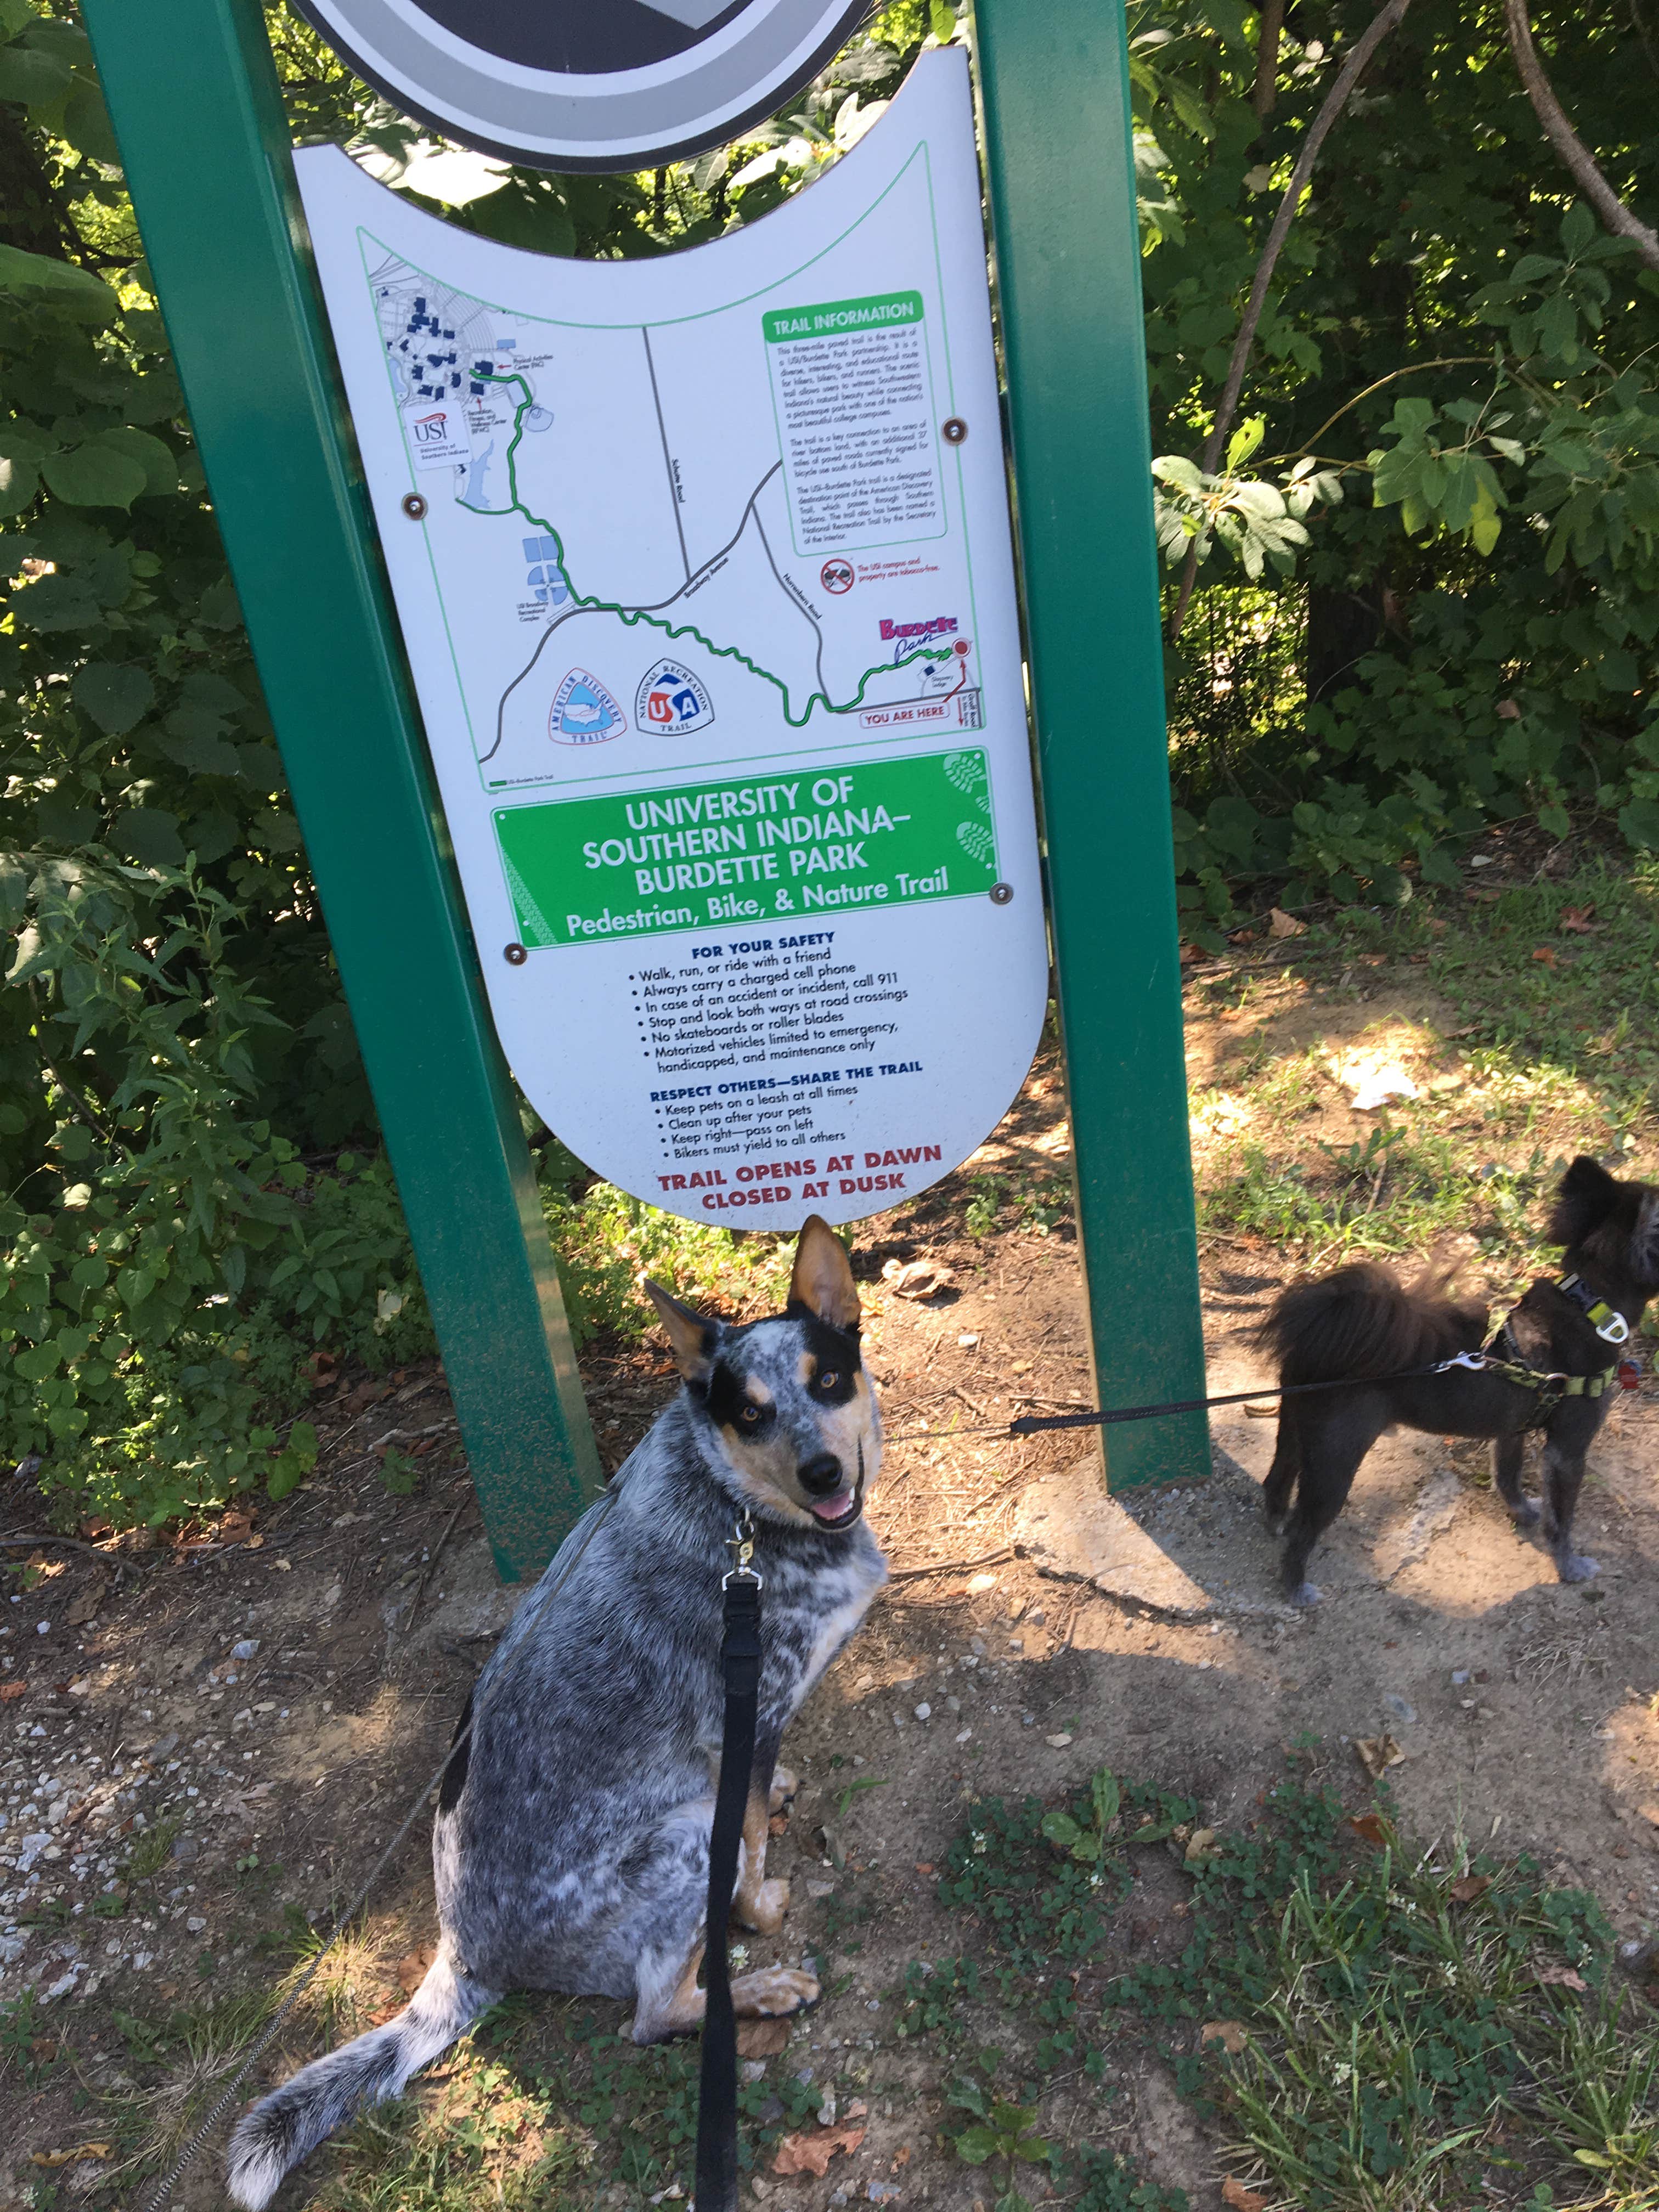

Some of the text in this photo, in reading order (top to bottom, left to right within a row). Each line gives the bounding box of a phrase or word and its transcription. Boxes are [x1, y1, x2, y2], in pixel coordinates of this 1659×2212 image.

[773, 301, 914, 335] TRAIL INFORMATION
[414, 419, 448, 442] USI
[420, 445, 448, 454] University
[421, 452, 447, 460] Southern
[676, 485, 686, 503] Road
[808, 603, 823, 620] Road
[551, 675, 622, 731] AMERICAN DISCOVERY
[640, 665, 708, 719] NATIONAL RECREATION
[661, 723, 692, 732] TRAIL
[865, 706, 944, 725] YOU ARE HERE
[572, 731, 607, 743] TRAIL
[625, 775, 854, 830] UNIVERSITY OF
[583, 823, 747, 869] SOUTHERN
[635, 841, 869, 895] BURDETTE PARK
[566, 866, 949, 936] Pedestrian, Bike, & Nature Trail
[692, 931, 835, 960] FOR YOUR SAFETY
[639, 947, 831, 981] Walk, run, or ride with a friend
[644, 984, 688, 997] Always
[691, 980, 724, 992] carry
[740, 968, 789, 986] charged
[793, 965, 814, 979] cell
[818, 963, 856, 980] phone
[646, 972, 898, 1013] In case of an accident or incident, call 911
[648, 989, 909, 1029] Stop and look both ways at road crossings
[651, 1011, 844, 1043] No skateboards or roller blades
[655, 1023, 898, 1058] Motorized vehicles limited to emergency,
[657, 1037, 876, 1073] handicapped, and maintenance only
[650, 1085, 712, 1102] RESPECT
[845, 1066, 874, 1079] THE
[878, 1061, 923, 1076] TRAIL
[665, 1104, 695, 1116] Keep
[699, 1101, 724, 1115] pets
[727, 1100, 742, 1109] on
[757, 1091, 789, 1105] leash
[793, 1091, 805, 1101] at
[809, 1086, 823, 1099] all
[827, 1086, 858, 1097] times
[668, 1105, 812, 1130] Clean up after your pets
[671, 1133, 701, 1145] Keep
[776, 1124, 791, 1133] on
[794, 1118, 814, 1130] left
[674, 1131, 846, 1159] Bikers must yield to all others
[656, 1144, 942, 1192] TRAIL OPENS AT DAWN
[702, 1172, 906, 1210] CLOSED AT DUSK
